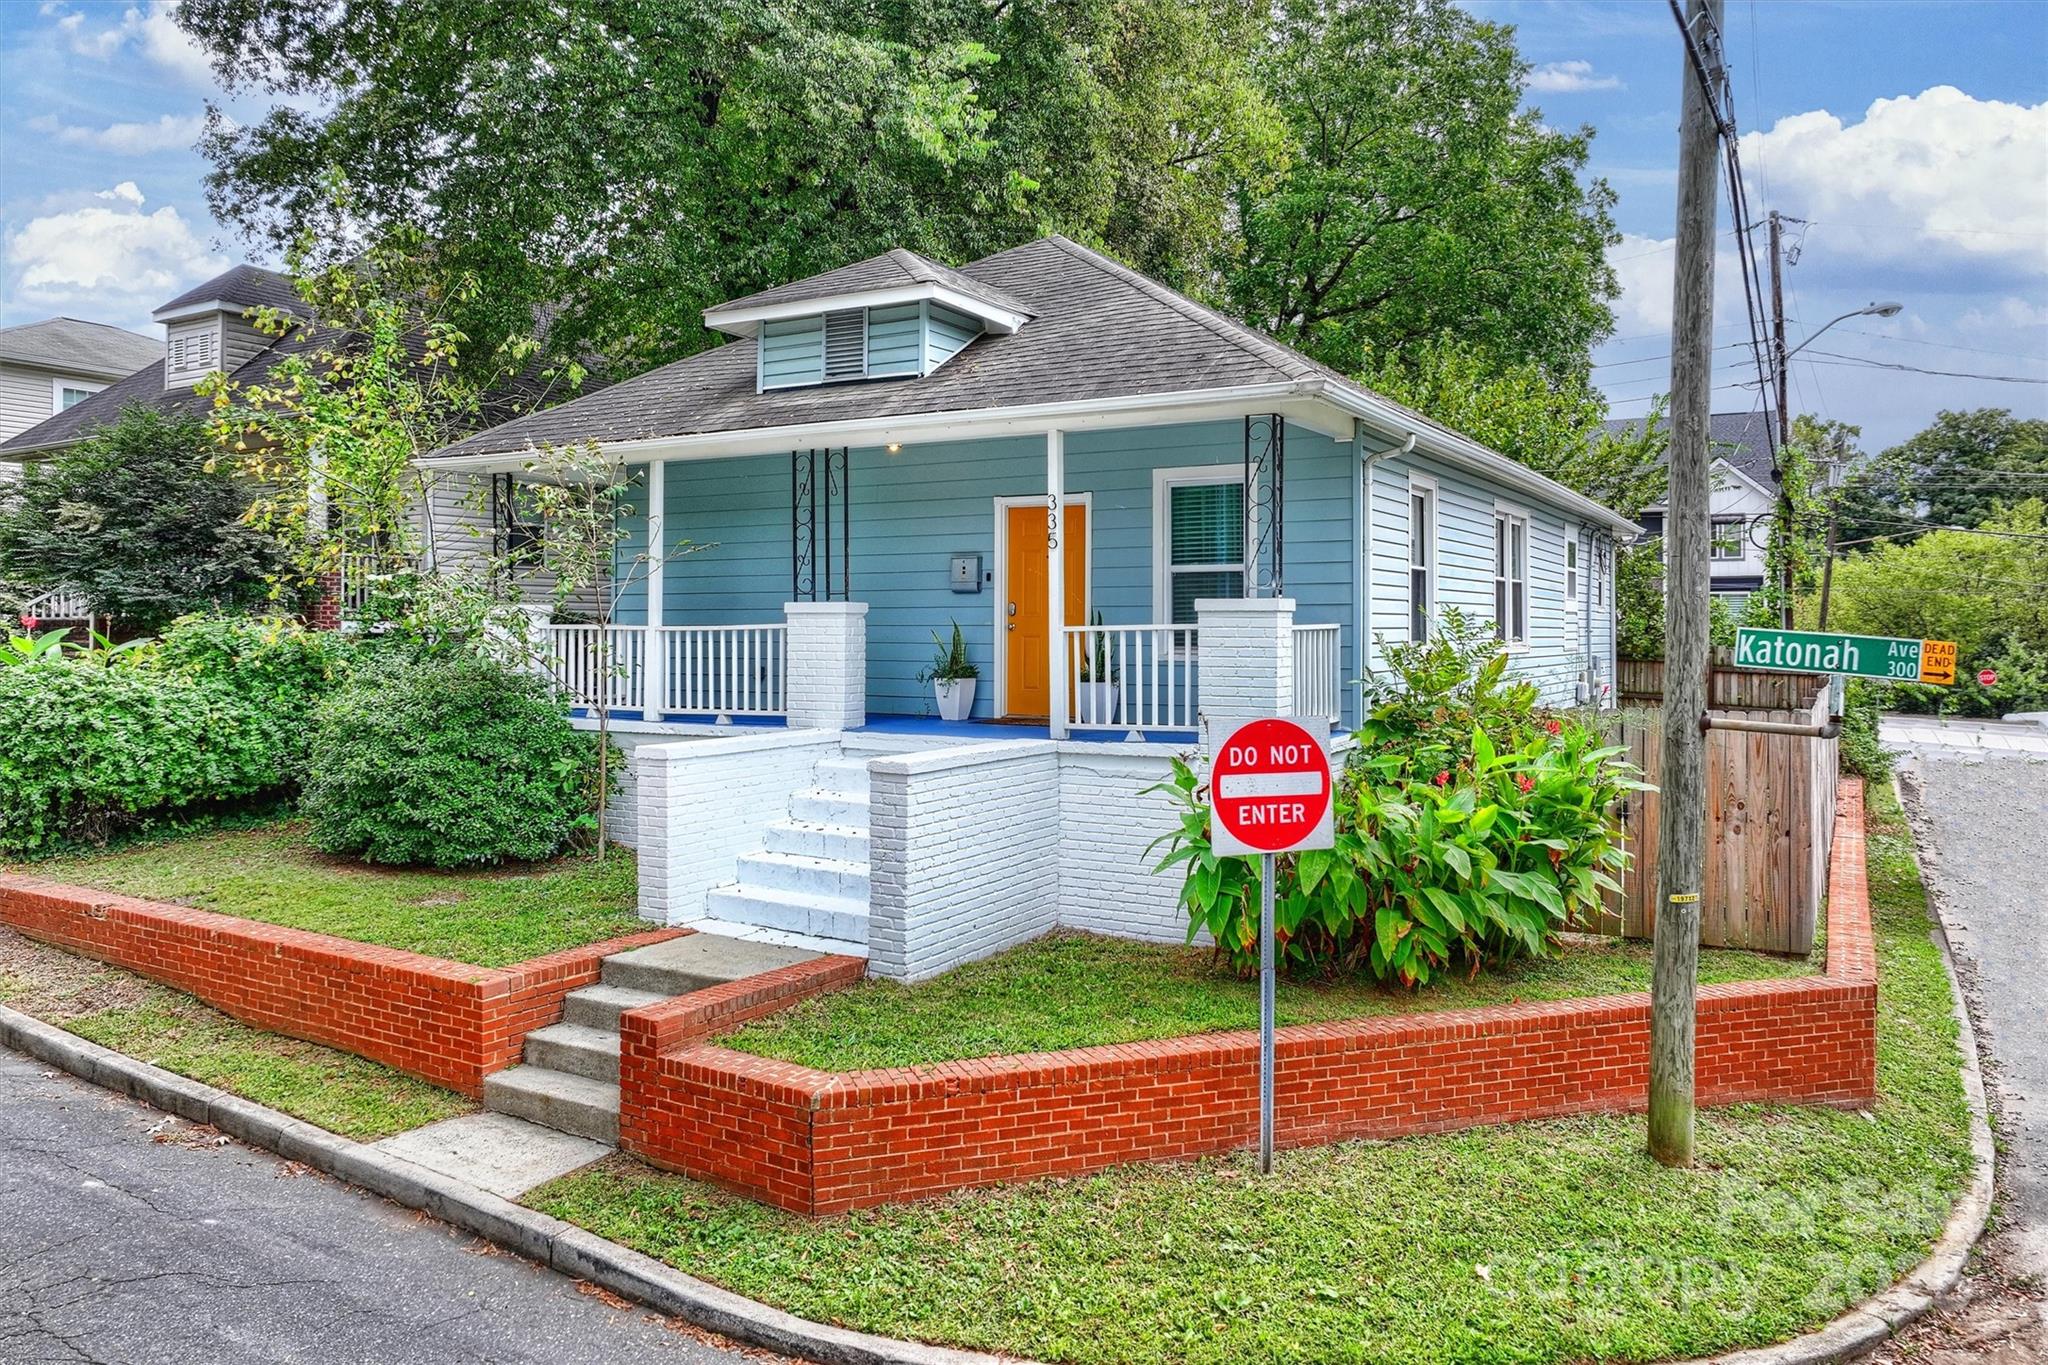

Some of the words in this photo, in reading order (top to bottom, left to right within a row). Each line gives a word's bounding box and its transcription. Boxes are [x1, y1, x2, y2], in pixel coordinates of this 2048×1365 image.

[1047, 493, 1058, 550] 335
[1739, 634, 1860, 671] Katonah
[1887, 641, 1919, 658] Ave
[1924, 643, 1955, 656] DEAD
[1887, 660, 1916, 678] 300
[1927, 656, 1949, 668] END
[1229, 746, 1258, 767] DO
[1270, 744, 1312, 765] NOT
[1238, 803, 1306, 826] ENTER
